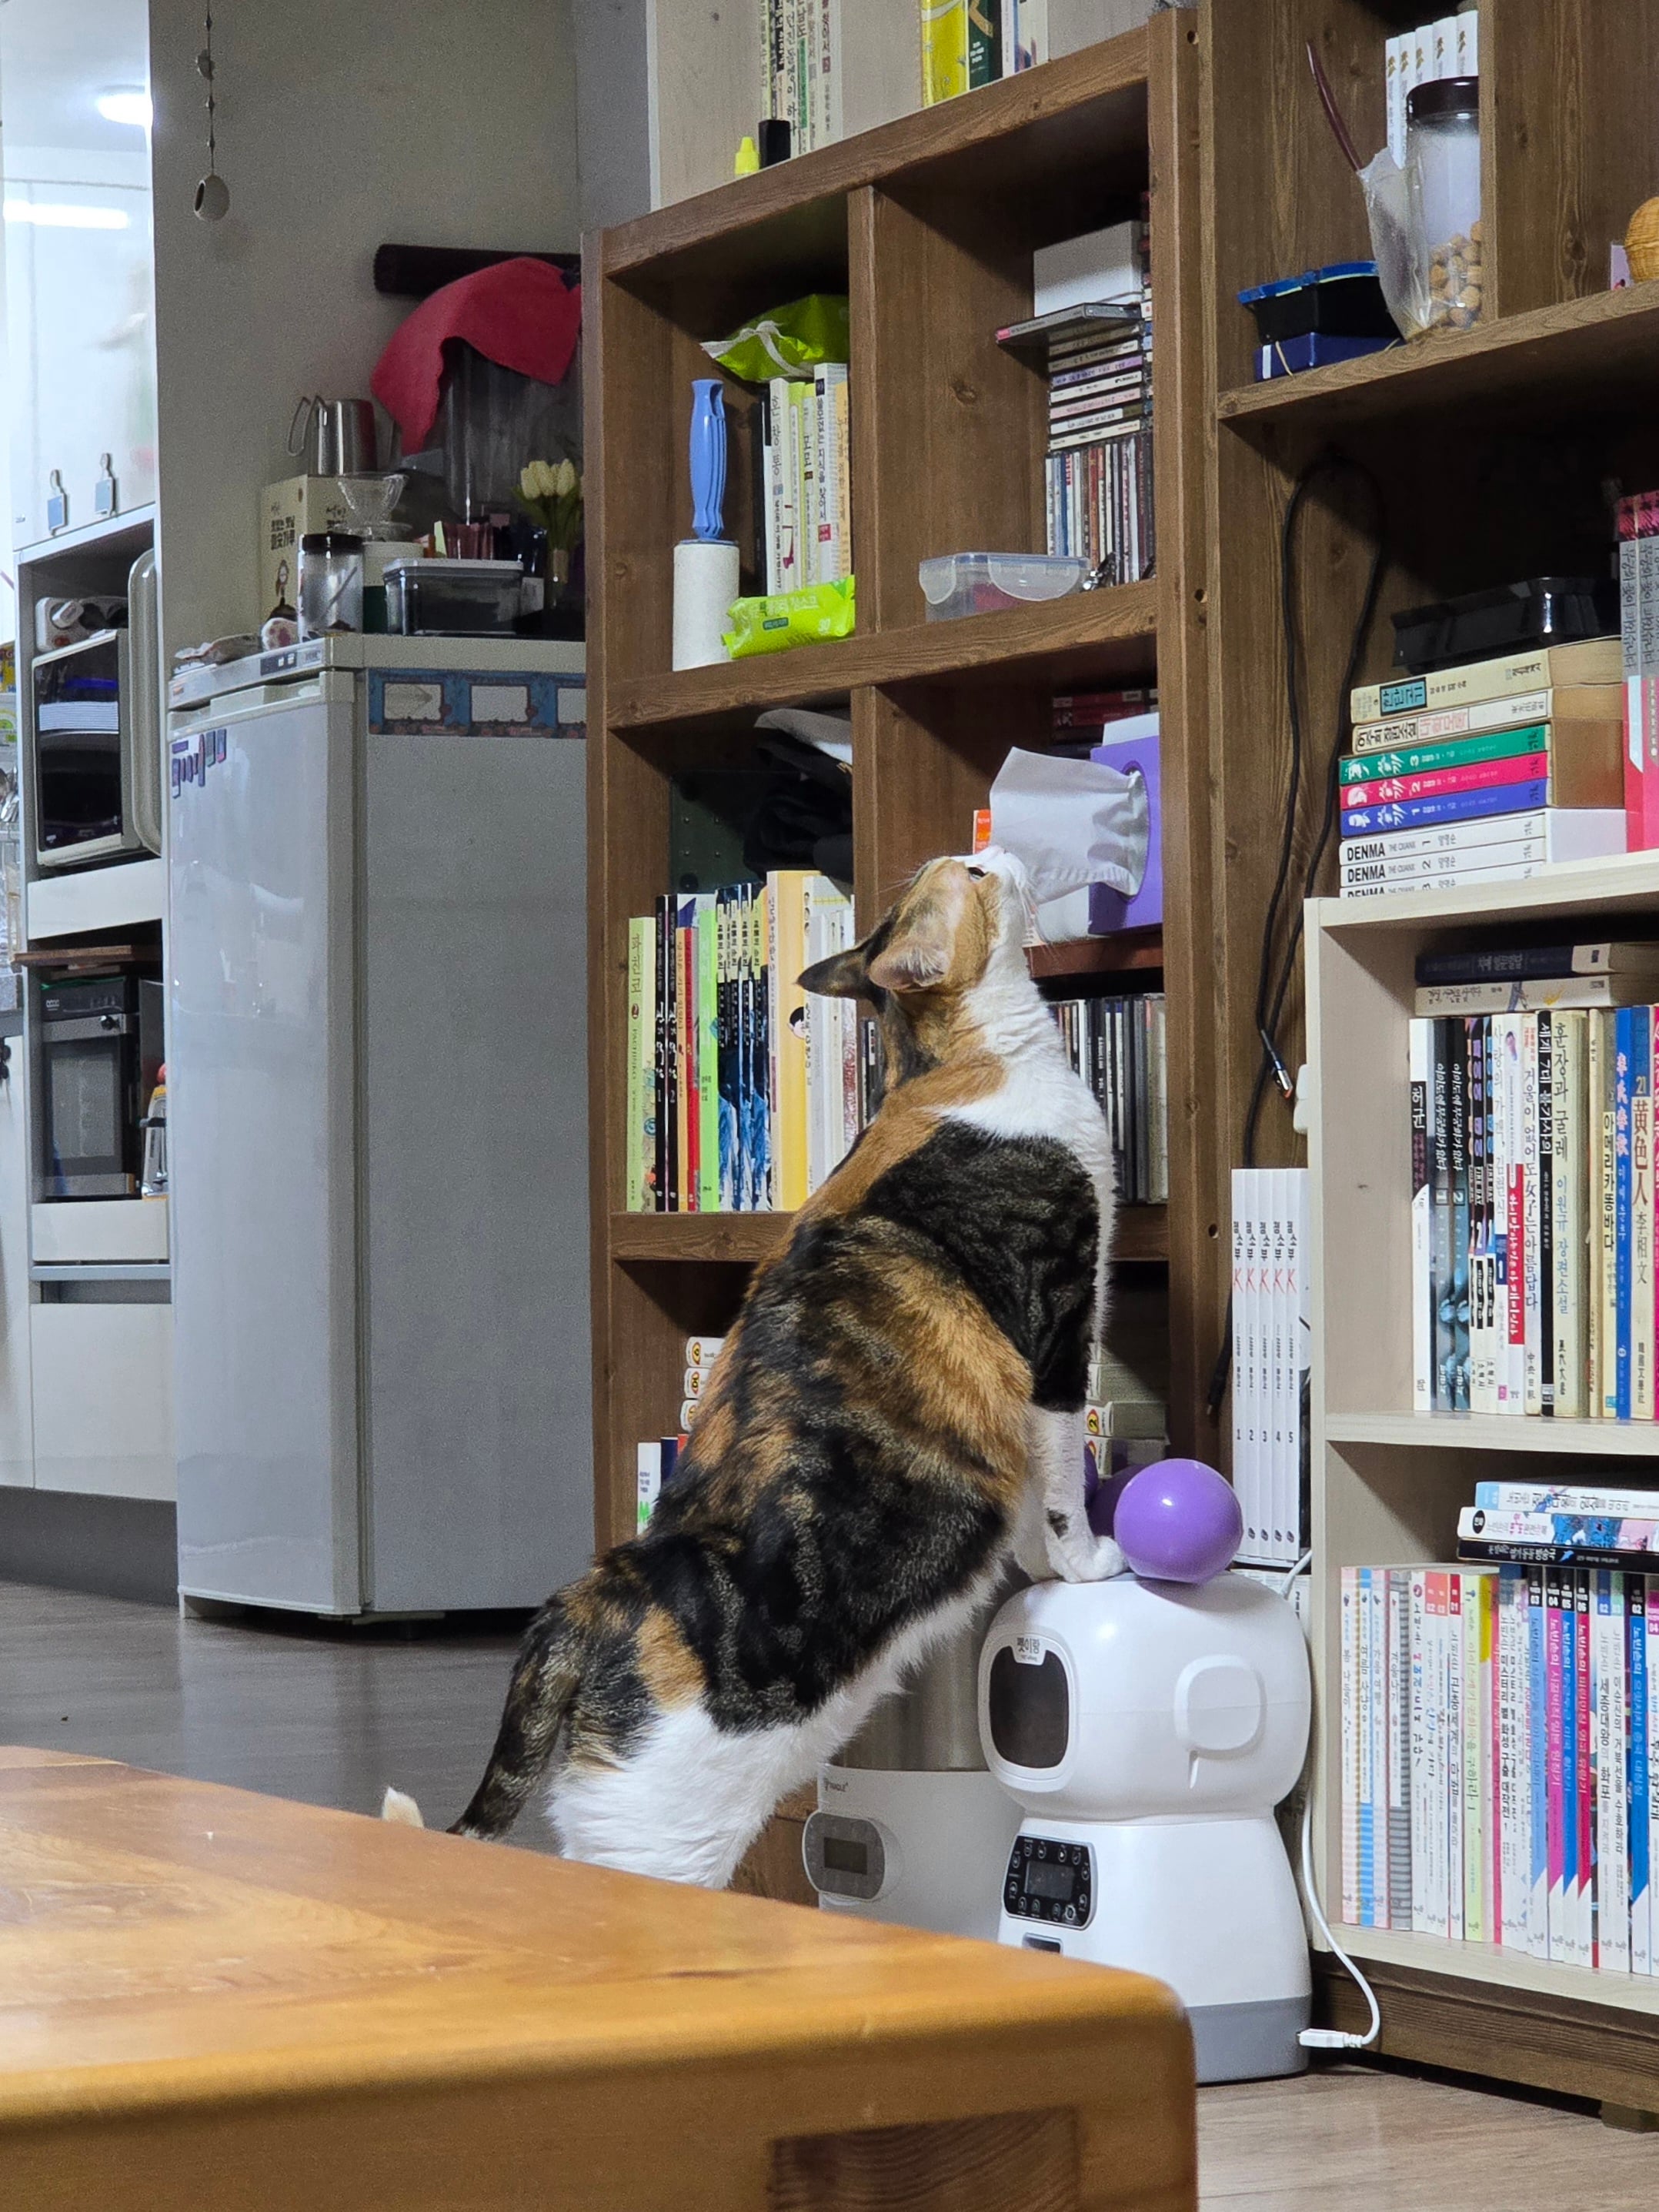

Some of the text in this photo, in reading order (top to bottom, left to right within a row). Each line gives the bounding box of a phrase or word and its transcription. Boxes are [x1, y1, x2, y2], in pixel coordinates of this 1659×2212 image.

[1409, 756, 1420, 767] 3
[1411, 781, 1420, 792] 2
[1411, 807, 1420, 816] 1
[1347, 842, 1385, 861] DENMA
[1347, 864, 1386, 884] DENMA
[1421, 860, 1431, 869] 2
[631, 933, 642, 994] 파친코
[1524, 1068, 1537, 1120] 거울이
[1539, 1022, 1552, 1155] 세계 7대 불가사의
[1554, 1022, 1570, 1163] 훈장과 굴레
[1635, 1076, 1647, 1095] 21
[1524, 1125, 1537, 1178] 없어도
[1633, 1100, 1649, 1206] 黃色人
[1436, 1192, 1447, 1203] 1
[1453, 1192, 1463, 1203] 2
[1604, 1114, 1615, 1253] 아메리카 똥바다
[1636, 1211, 1648, 1285] 李相文
[1233, 1267, 1244, 1295] K
[1247, 1267, 1257, 1295] K
[1259, 1267, 1271, 1295] K
[1273, 1267, 1284, 1295] K
[1286, 1267, 1297, 1295] K
[1524, 1236, 1538, 1311] 아름답다
[1556, 1238, 1570, 1315] 장편소설
[1549, 1617, 1560, 1666] 노빈손의
[1563, 1620, 1571, 1669] 노빈손의
[1577, 1623, 1587, 1672] 노빈손의
[1633, 1626, 1643, 1675] 노빈손의
[1613, 1676, 1622, 1732] 이순신의
